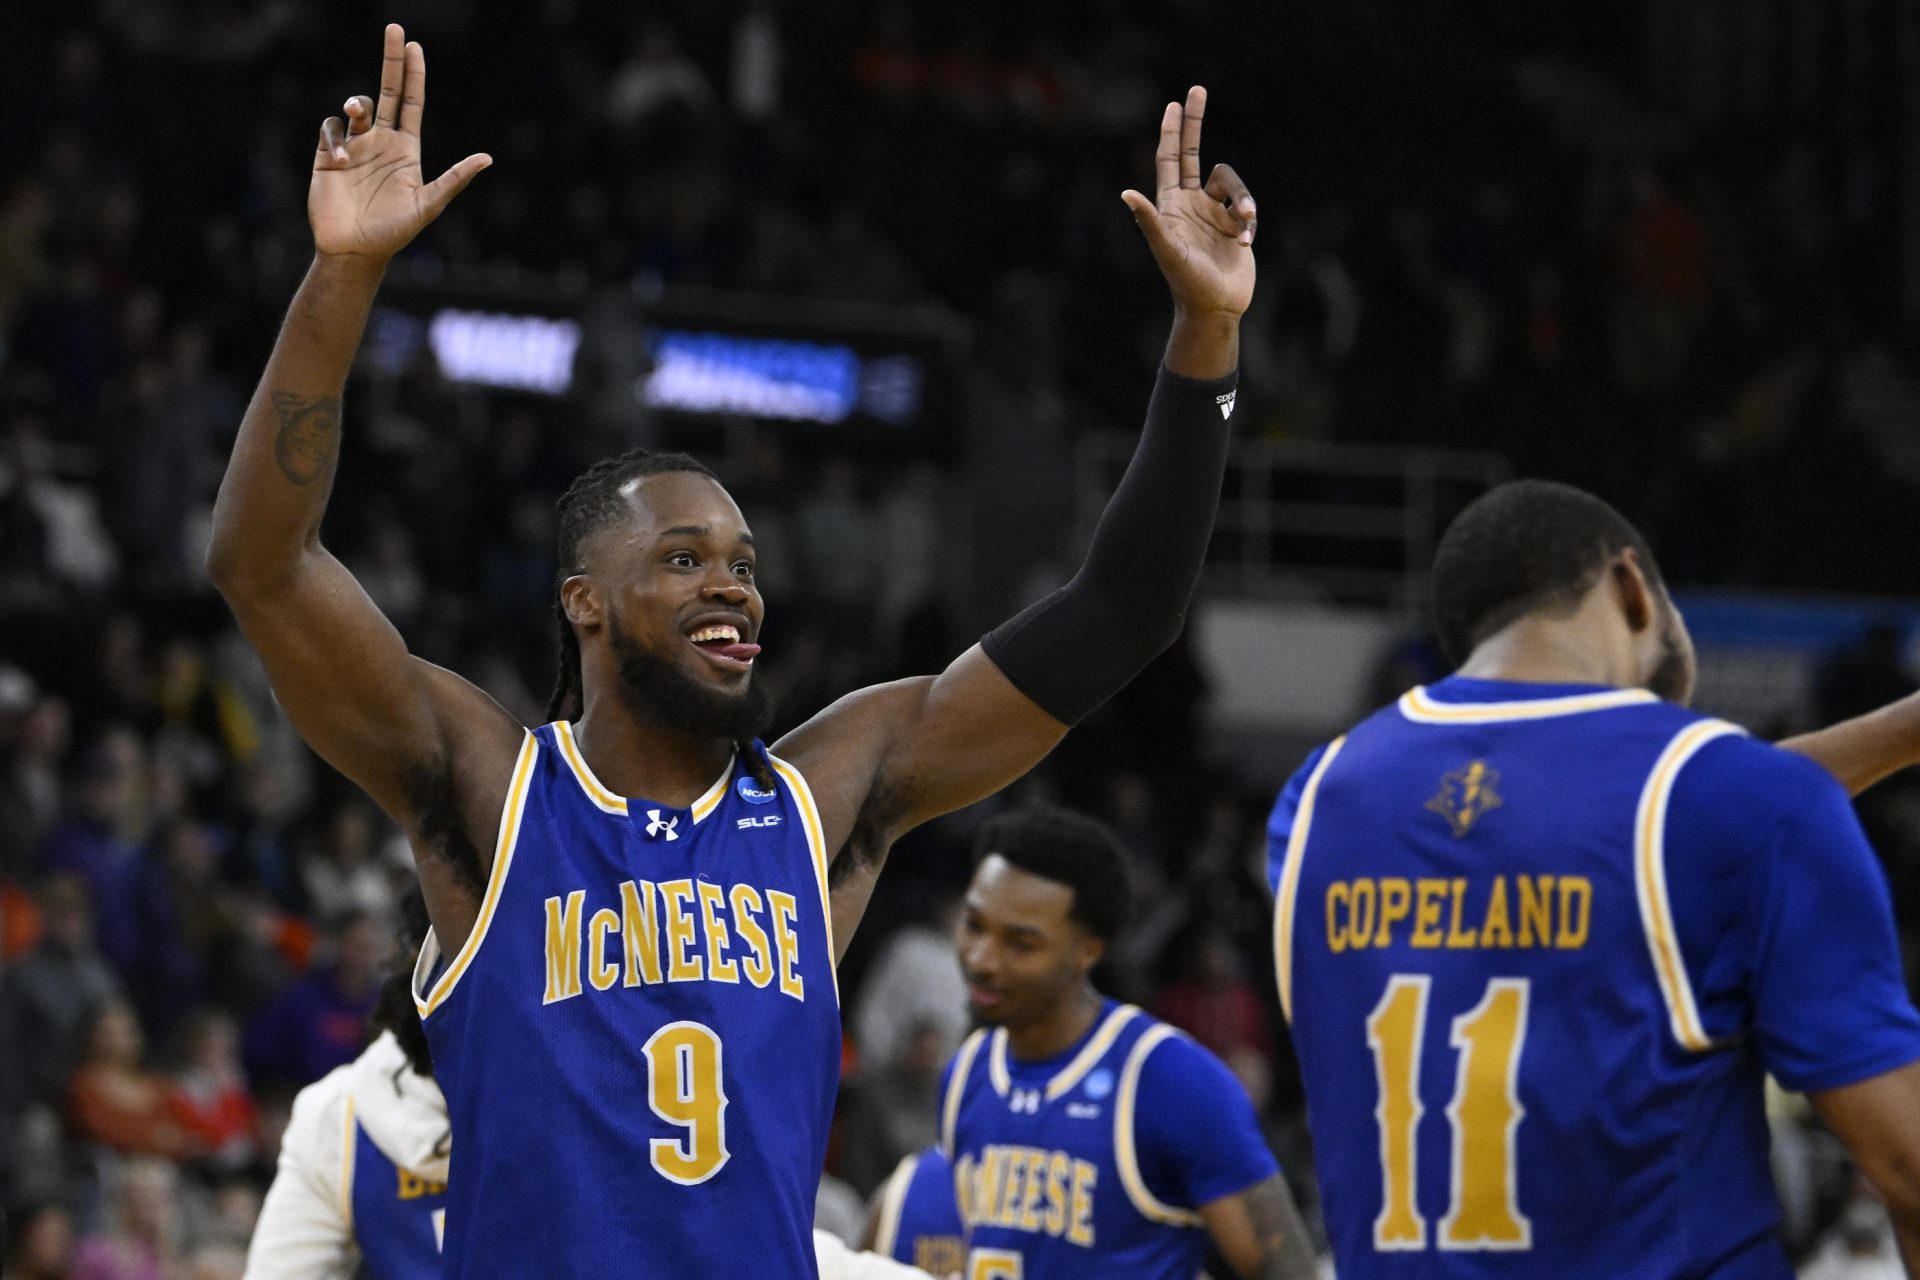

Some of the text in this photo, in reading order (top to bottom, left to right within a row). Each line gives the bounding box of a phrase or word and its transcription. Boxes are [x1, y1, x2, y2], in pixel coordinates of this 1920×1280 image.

[737, 815, 782, 829] SLC
[542, 879, 804, 1005] McNEESE
[1325, 874, 1592, 952] COPELAND
[641, 1020, 731, 1186] 9
[1366, 974, 1532, 1251] 11
